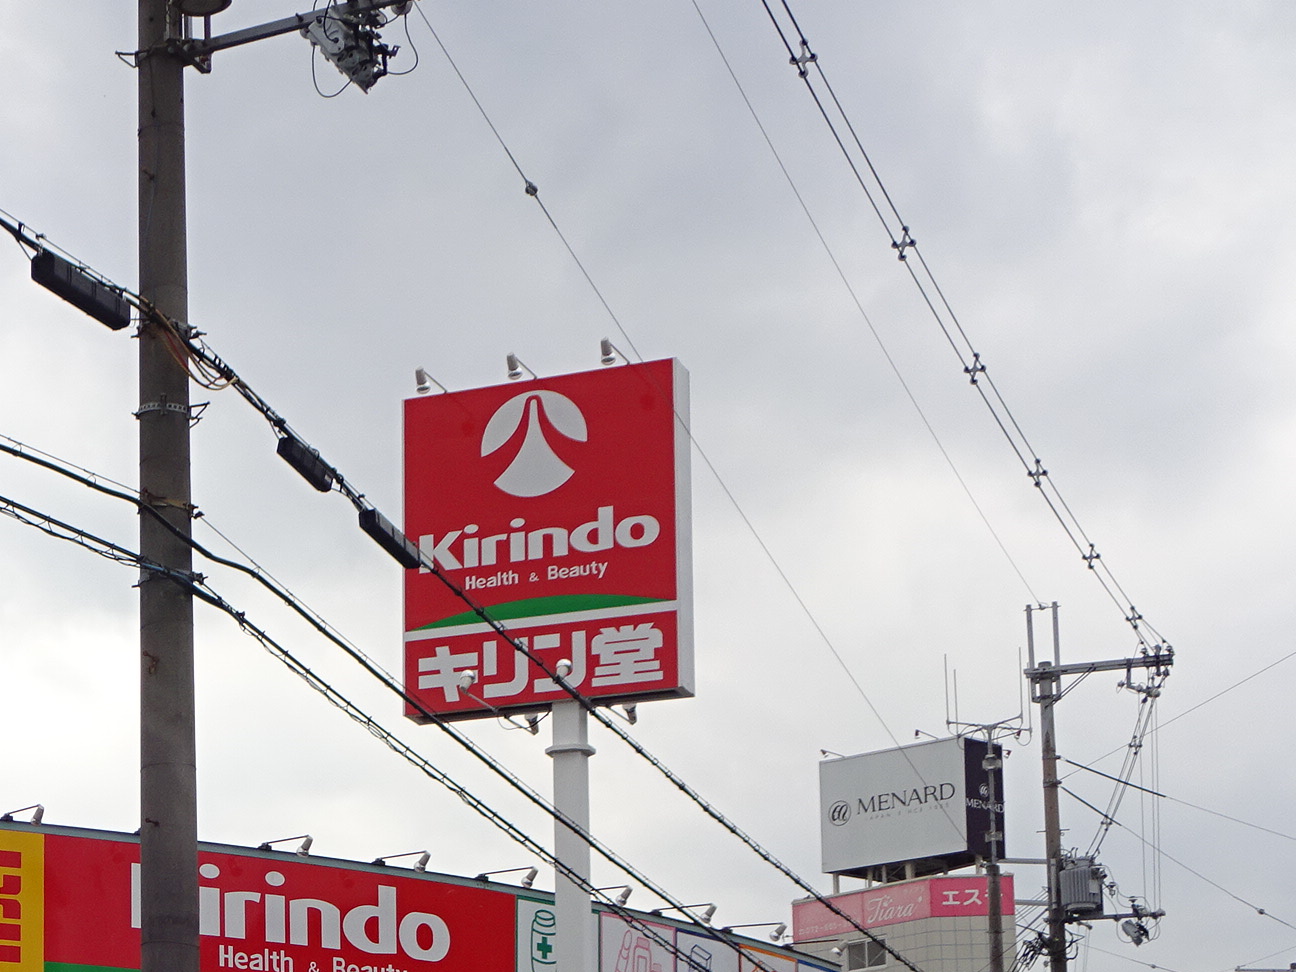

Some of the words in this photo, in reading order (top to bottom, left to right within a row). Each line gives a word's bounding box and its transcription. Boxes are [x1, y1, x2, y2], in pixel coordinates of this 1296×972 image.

[418, 505, 661, 574] Kirindo
[465, 569, 519, 590] Health
[529, 572, 540, 582] &
[547, 560, 608, 580] Beauty
[418, 622, 664, 702] キリン堂
[857, 782, 955, 815] MENARD
[131, 861, 451, 962] irindo
[867, 896, 916, 924] Tiara
